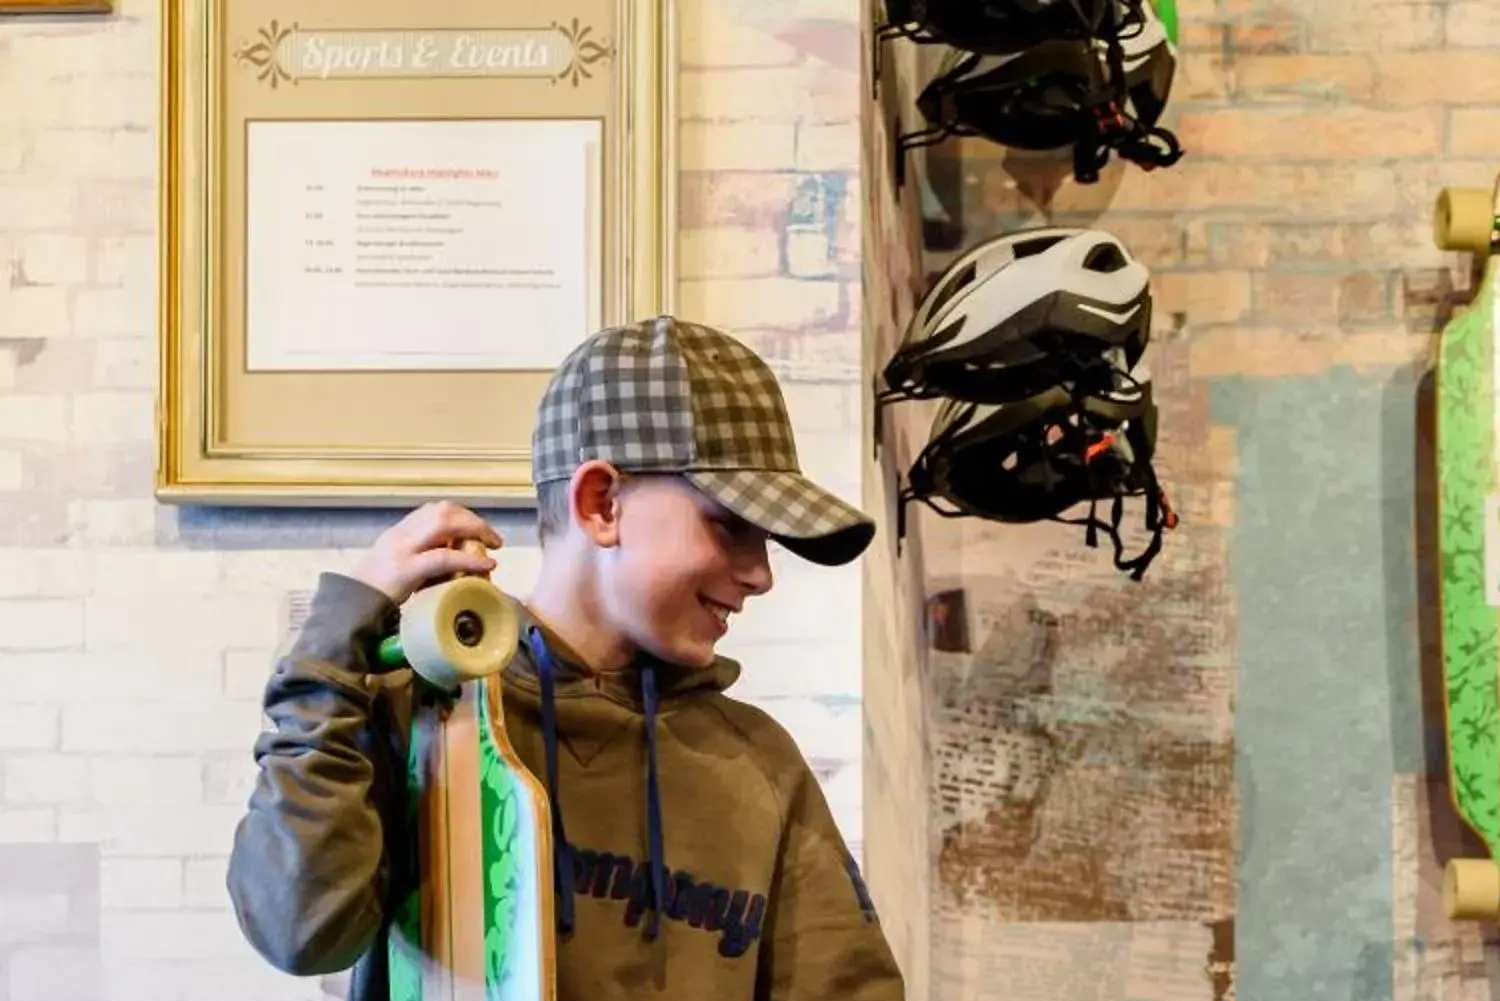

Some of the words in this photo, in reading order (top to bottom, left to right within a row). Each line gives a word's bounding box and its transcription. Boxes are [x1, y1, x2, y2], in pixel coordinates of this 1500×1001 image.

[302, 36, 404, 79] Sports
[411, 36, 441, 69] &
[449, 34, 549, 69] Events
